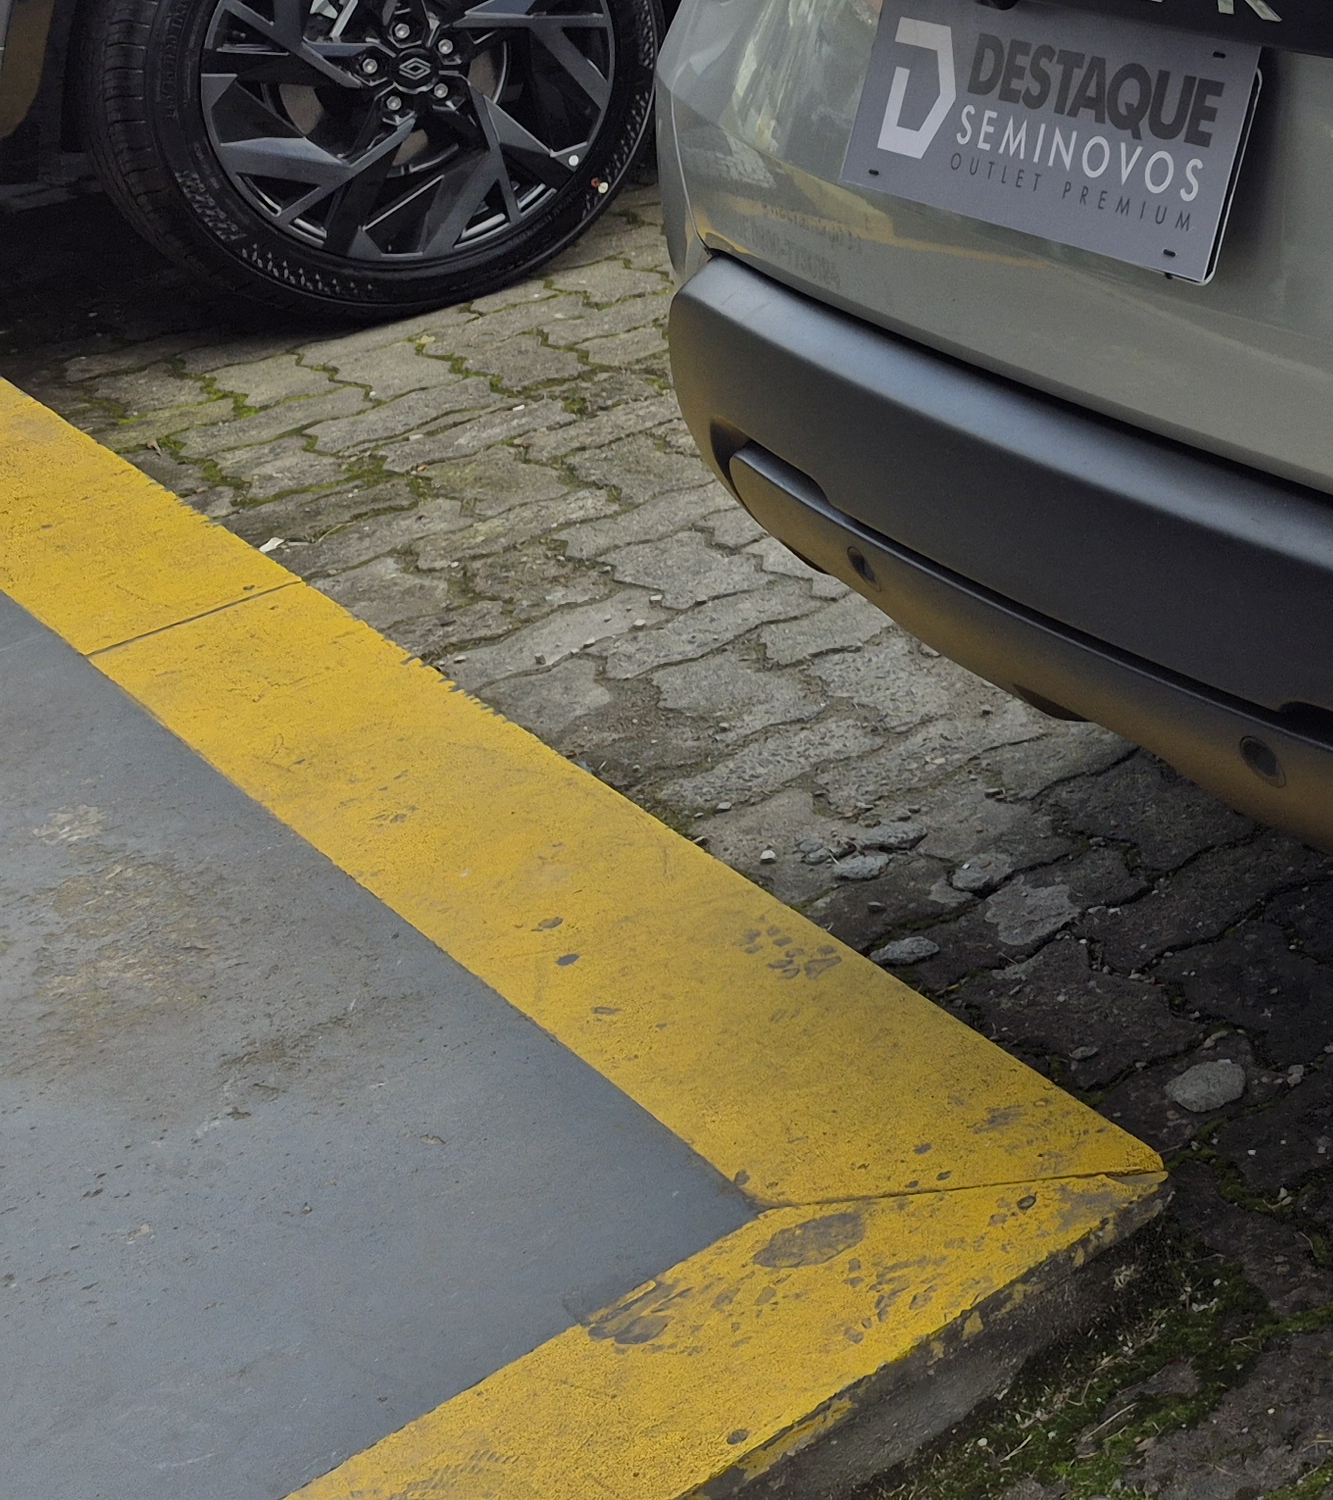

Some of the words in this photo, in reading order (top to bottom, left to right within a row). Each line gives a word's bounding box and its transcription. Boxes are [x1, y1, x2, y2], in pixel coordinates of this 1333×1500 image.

[967, 32, 1225, 148] DESTAQUE
[949, 152, 1042, 192] OUTLET
[1062, 181, 1193, 232] PREMIUM
[956, 104, 1204, 202] SEMINOVOS
